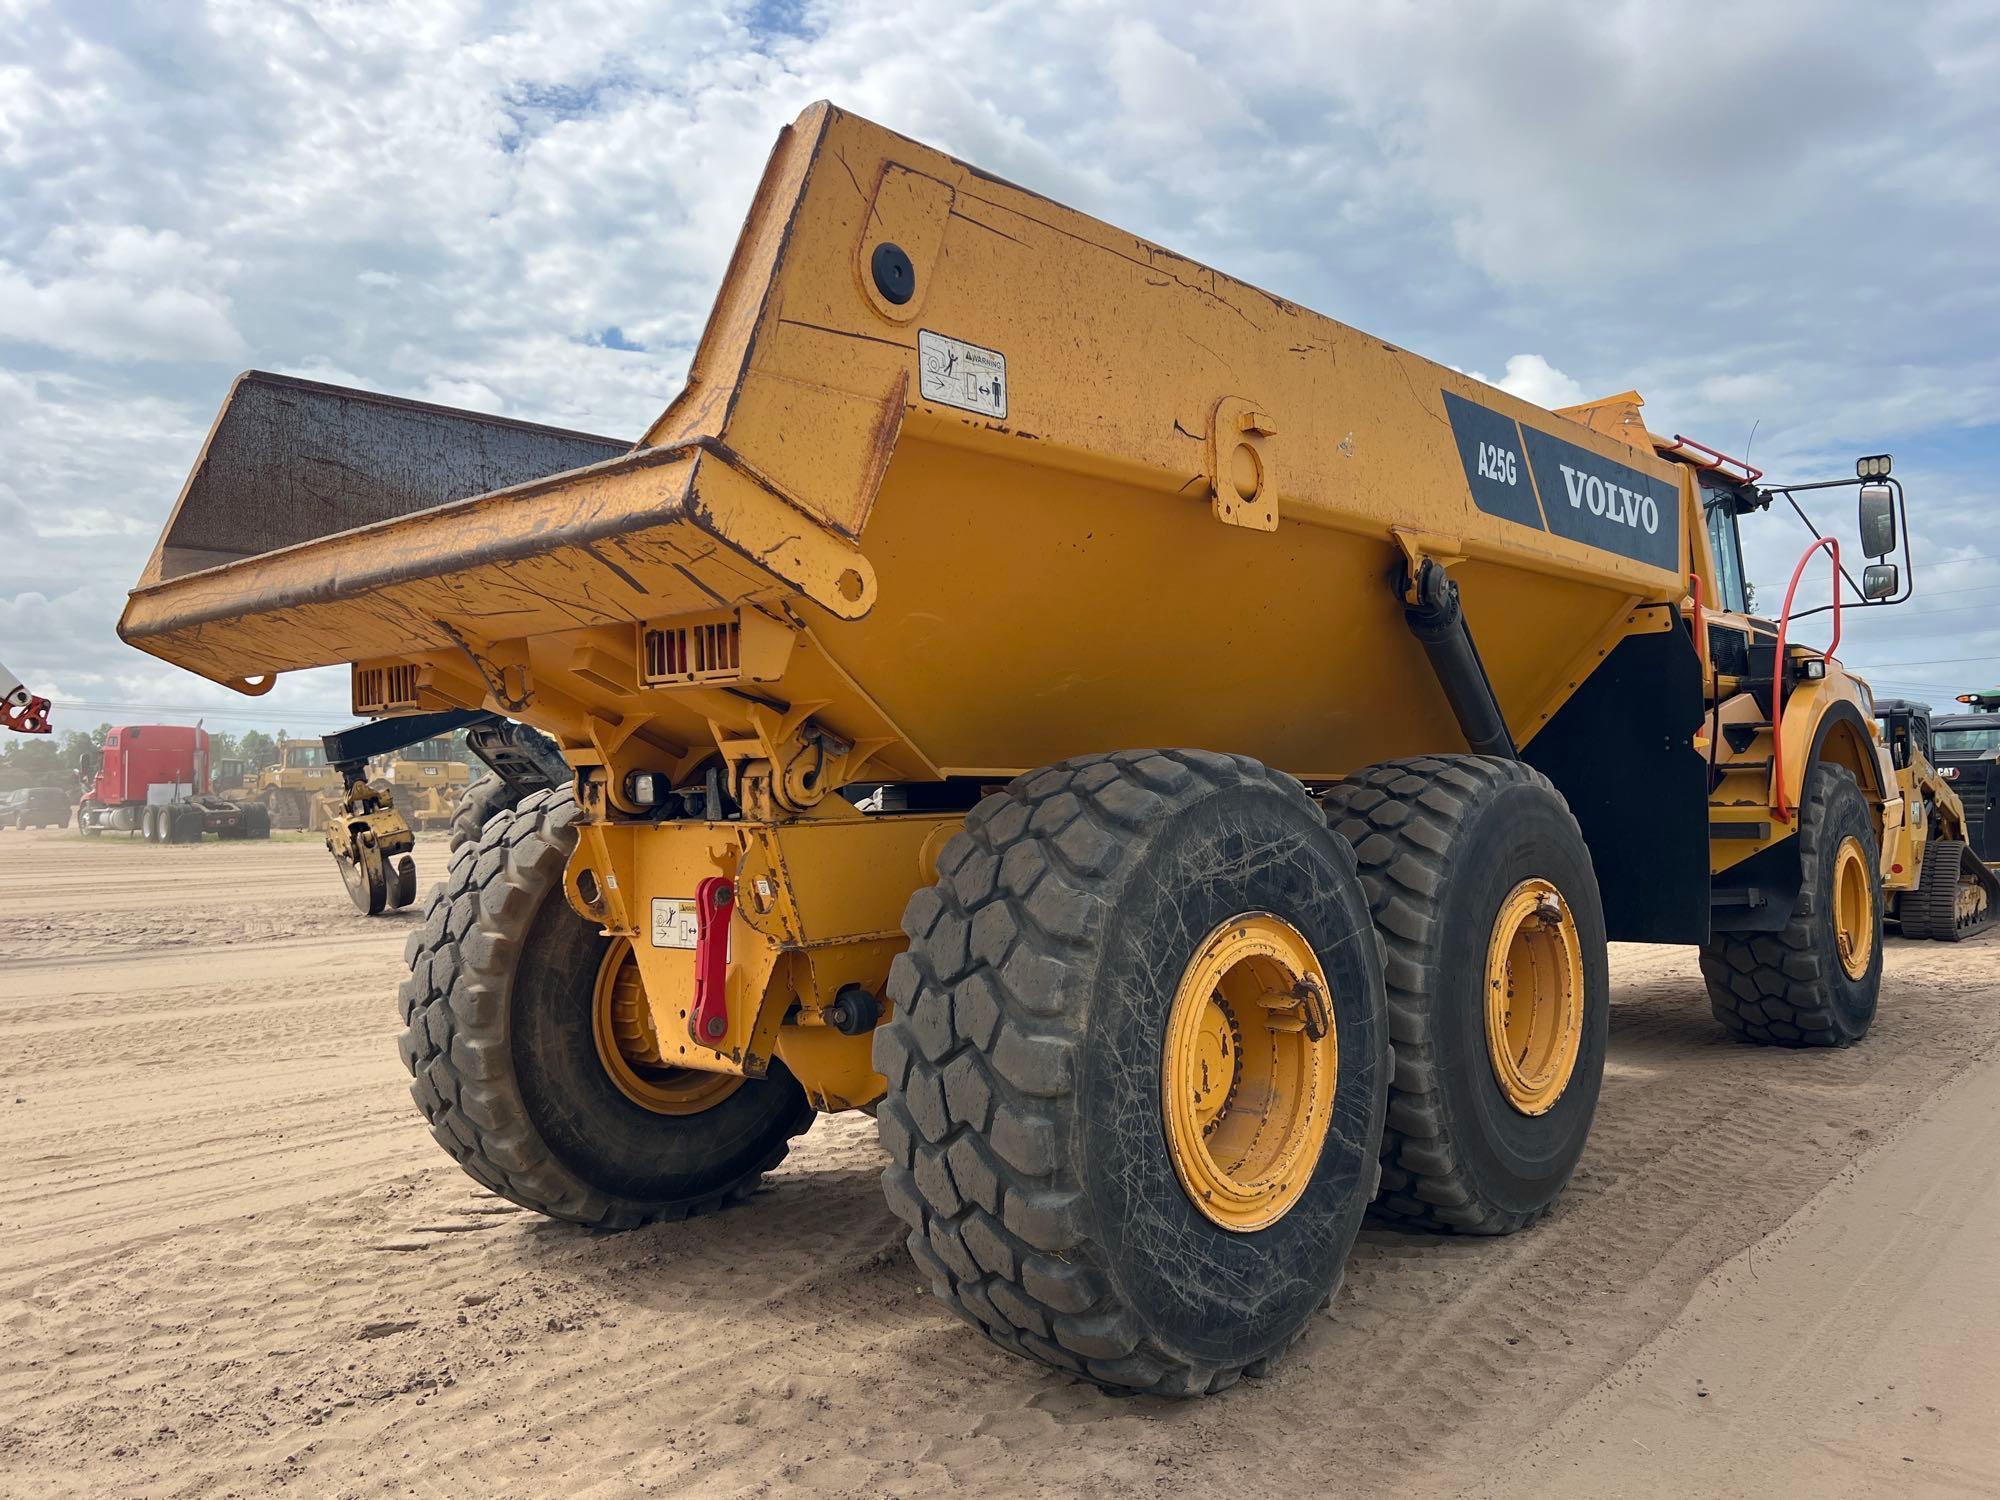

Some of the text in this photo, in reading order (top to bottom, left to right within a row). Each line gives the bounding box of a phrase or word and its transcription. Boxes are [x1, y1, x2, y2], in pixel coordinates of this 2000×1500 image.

[972, 354, 1002, 370] WARNING
[1478, 441, 1517, 486] A25G
[1559, 464, 1659, 534] VOLVO
[1937, 767, 1955, 777] CAT
